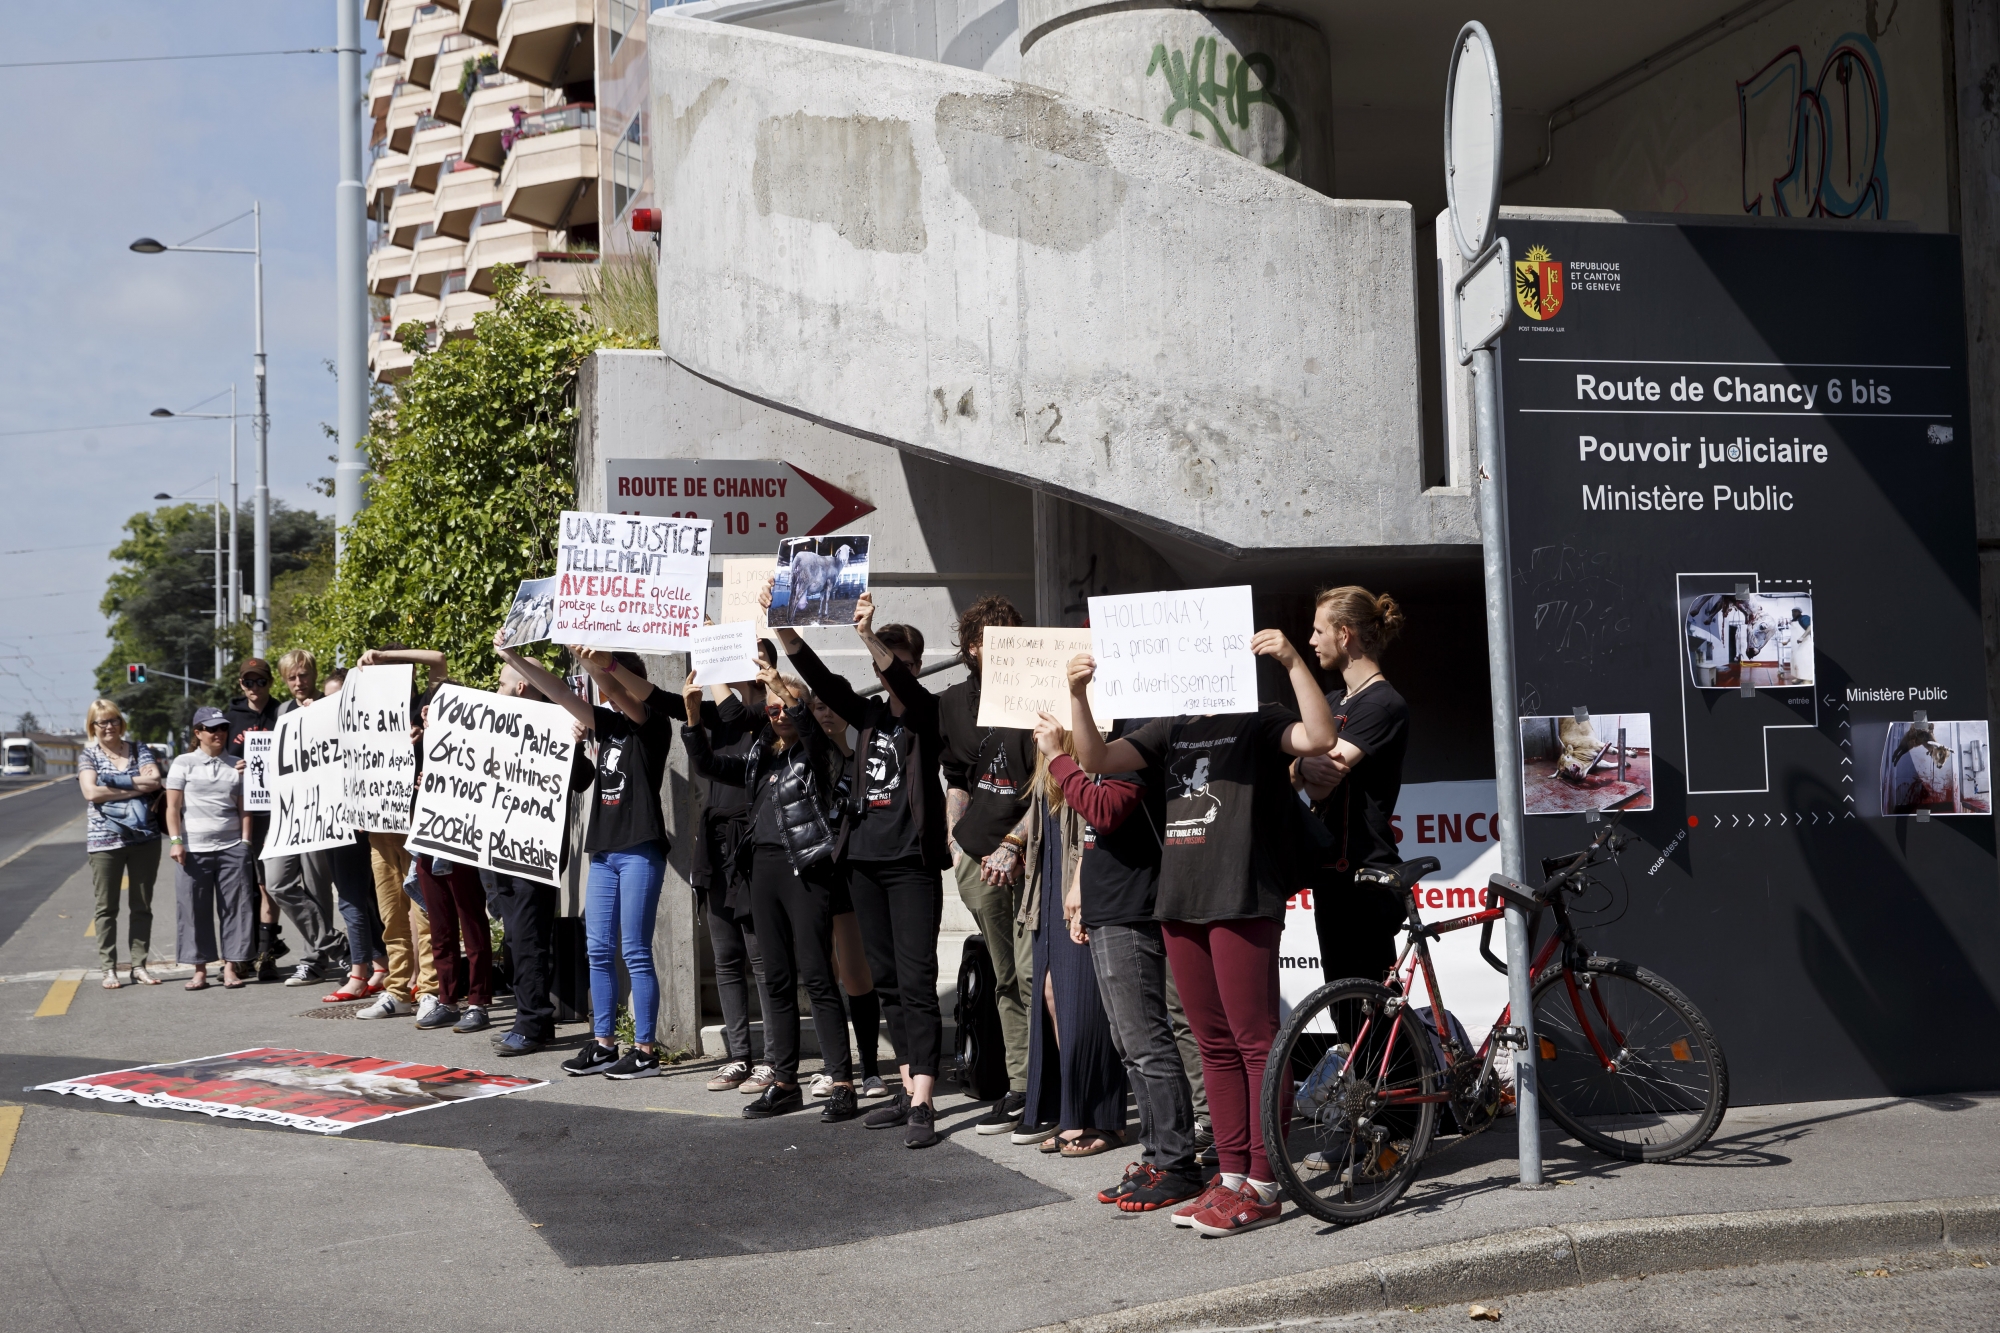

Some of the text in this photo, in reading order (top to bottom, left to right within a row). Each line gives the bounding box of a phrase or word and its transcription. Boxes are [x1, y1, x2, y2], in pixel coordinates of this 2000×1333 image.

[1570, 262, 1620, 271] REPUBLIQUE
[1571, 272, 1621, 281] ET CANTON
[1571, 282, 1621, 291] DE GENEVE
[1576, 374, 1892, 410] Route de Chancy 6 bis
[1579, 435, 1829, 469] Pouvoir judiciaire
[618, 477, 788, 498] ROUTE DE CHANCY
[1582, 484, 1794, 511] Ministère Public
[724, 511, 749, 535] 10
[776, 512, 789, 535] 8
[566, 517, 708, 556] UNE JUSTICE
[562, 545, 668, 576] TELLEMENT
[559, 573, 646, 598] AVEUGLE
[730, 565, 742, 585] La
[728, 590, 760, 606] OBSOL
[559, 599, 700, 620] protège les OPPRESSEURS
[1103, 597, 1210, 629] HOLLOWAY,
[557, 619, 569, 629] au
[627, 621, 641, 633] des
[643, 621, 698, 637] OPPRIMÉ
[713, 633, 735, 641] violence
[1068, 640, 1093, 651] ACTIV
[1101, 634, 1245, 663] La prison c'est pas
[990, 655, 1015, 667] REND
[1026, 656, 1058, 668] SERVICE
[991, 671, 1068, 688] MAIS JUSTIC
[1105, 665, 1237, 697] un divertissement
[1004, 695, 1056, 713] PERSONNE
[1788, 697, 1810, 705] entrée
[1846, 687, 1948, 702] Ministère Public
[377, 702, 406, 732] ami
[432, 692, 570, 761] Vous nous parlez
[278, 716, 343, 776] Libérez
[429, 731, 475, 771] bris
[483, 747, 500, 780] de
[389, 749, 416, 772] depuis
[369, 780, 384, 797] car
[424, 772, 555, 823] on vous répond
[1647, 828, 1686, 876] vous êtes ici
[1279, 955, 1323, 969] men
